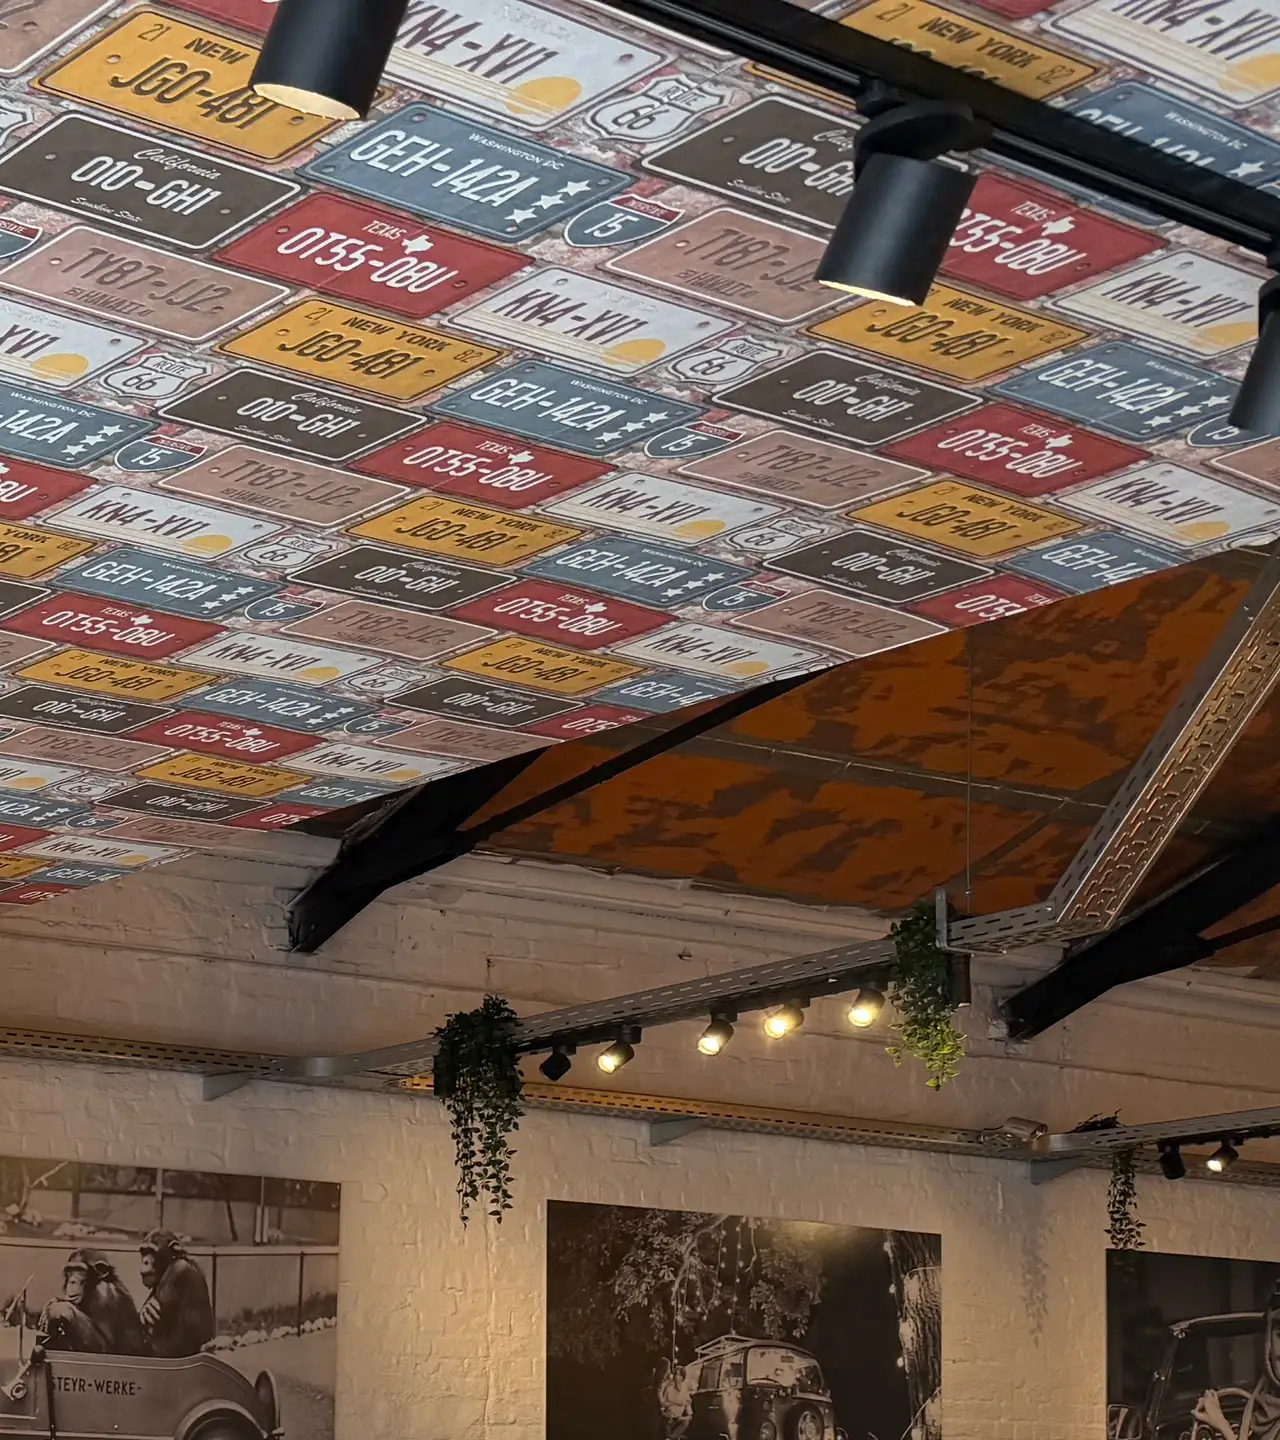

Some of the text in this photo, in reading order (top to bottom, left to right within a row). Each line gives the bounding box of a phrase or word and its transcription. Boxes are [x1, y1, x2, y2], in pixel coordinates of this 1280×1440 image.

[119, 150, 222, 180] California
[348, 132, 541, 205] GEH-142A
[63, 248, 233, 311] TY87-JJ2
[469, 379, 629, 430] GEH-142A
